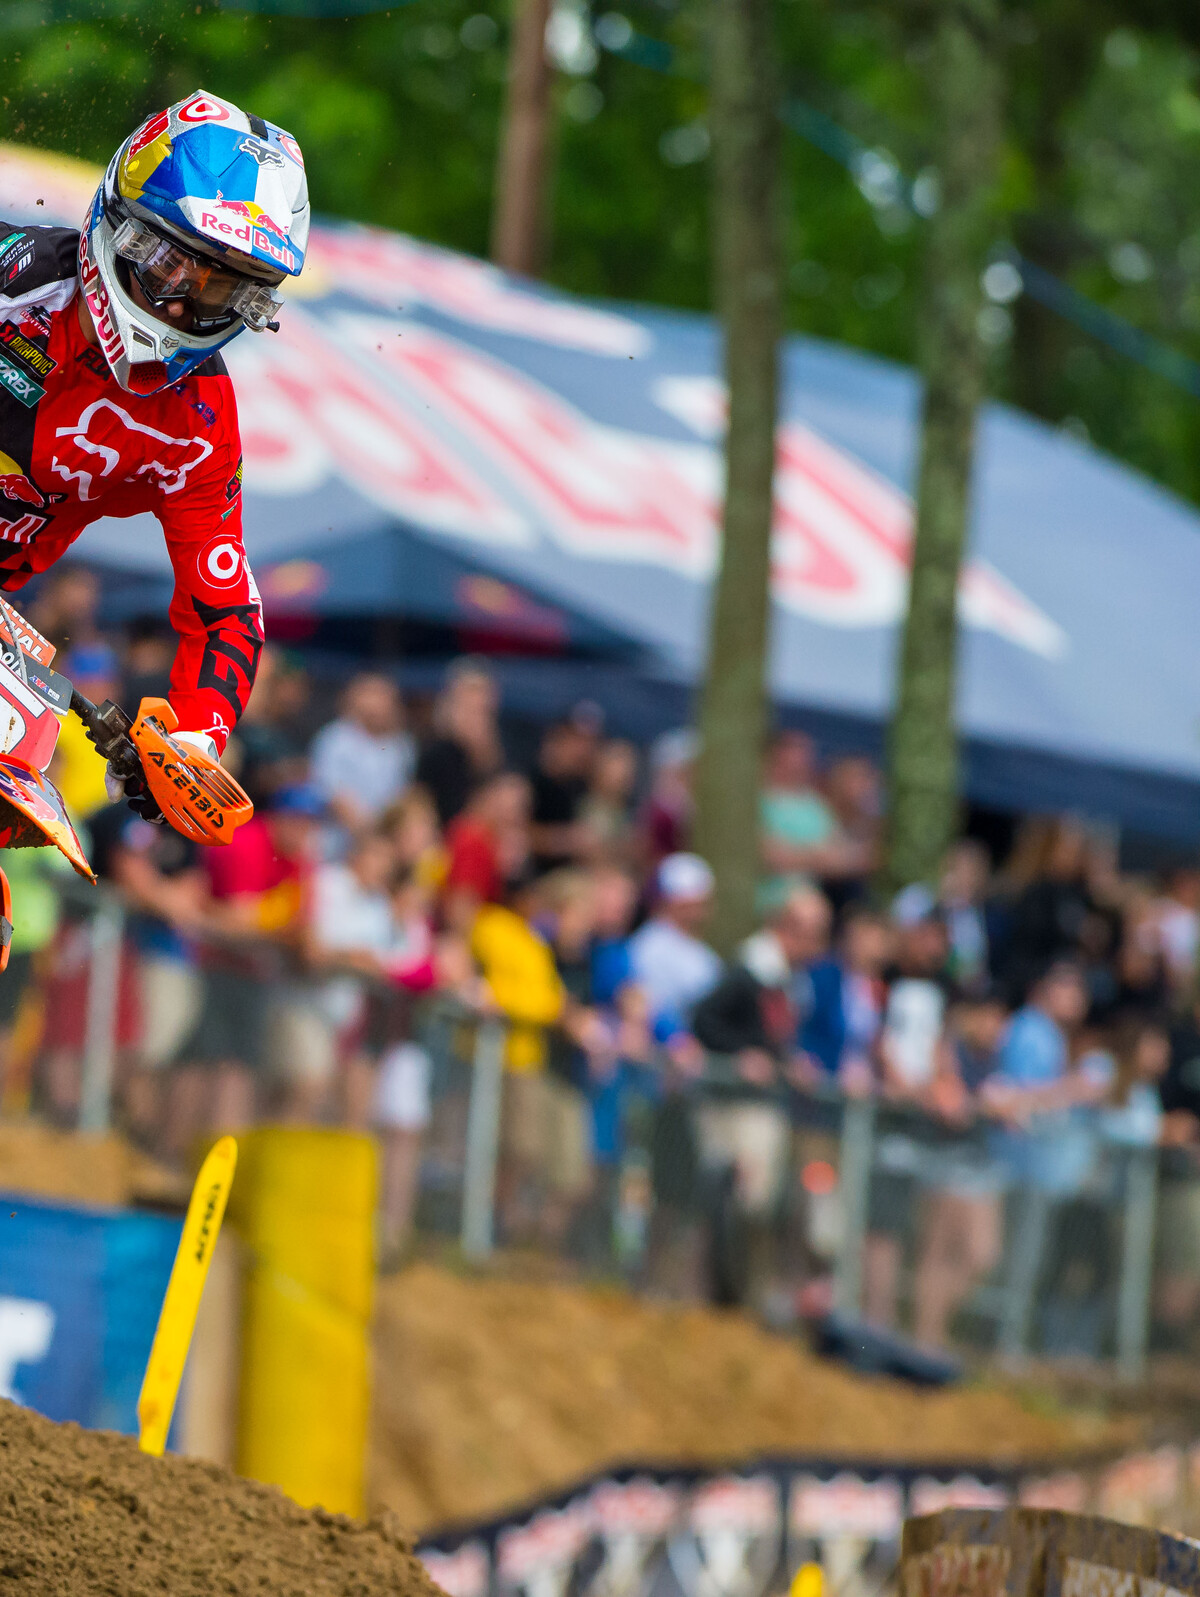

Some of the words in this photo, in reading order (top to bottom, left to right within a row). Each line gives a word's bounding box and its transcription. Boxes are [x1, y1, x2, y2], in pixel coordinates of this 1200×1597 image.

[202, 212, 250, 242] Red
[254, 229, 295, 272] Bull
[86, 281, 125, 365] Bull
[147, 752, 225, 828] ACERBIS
